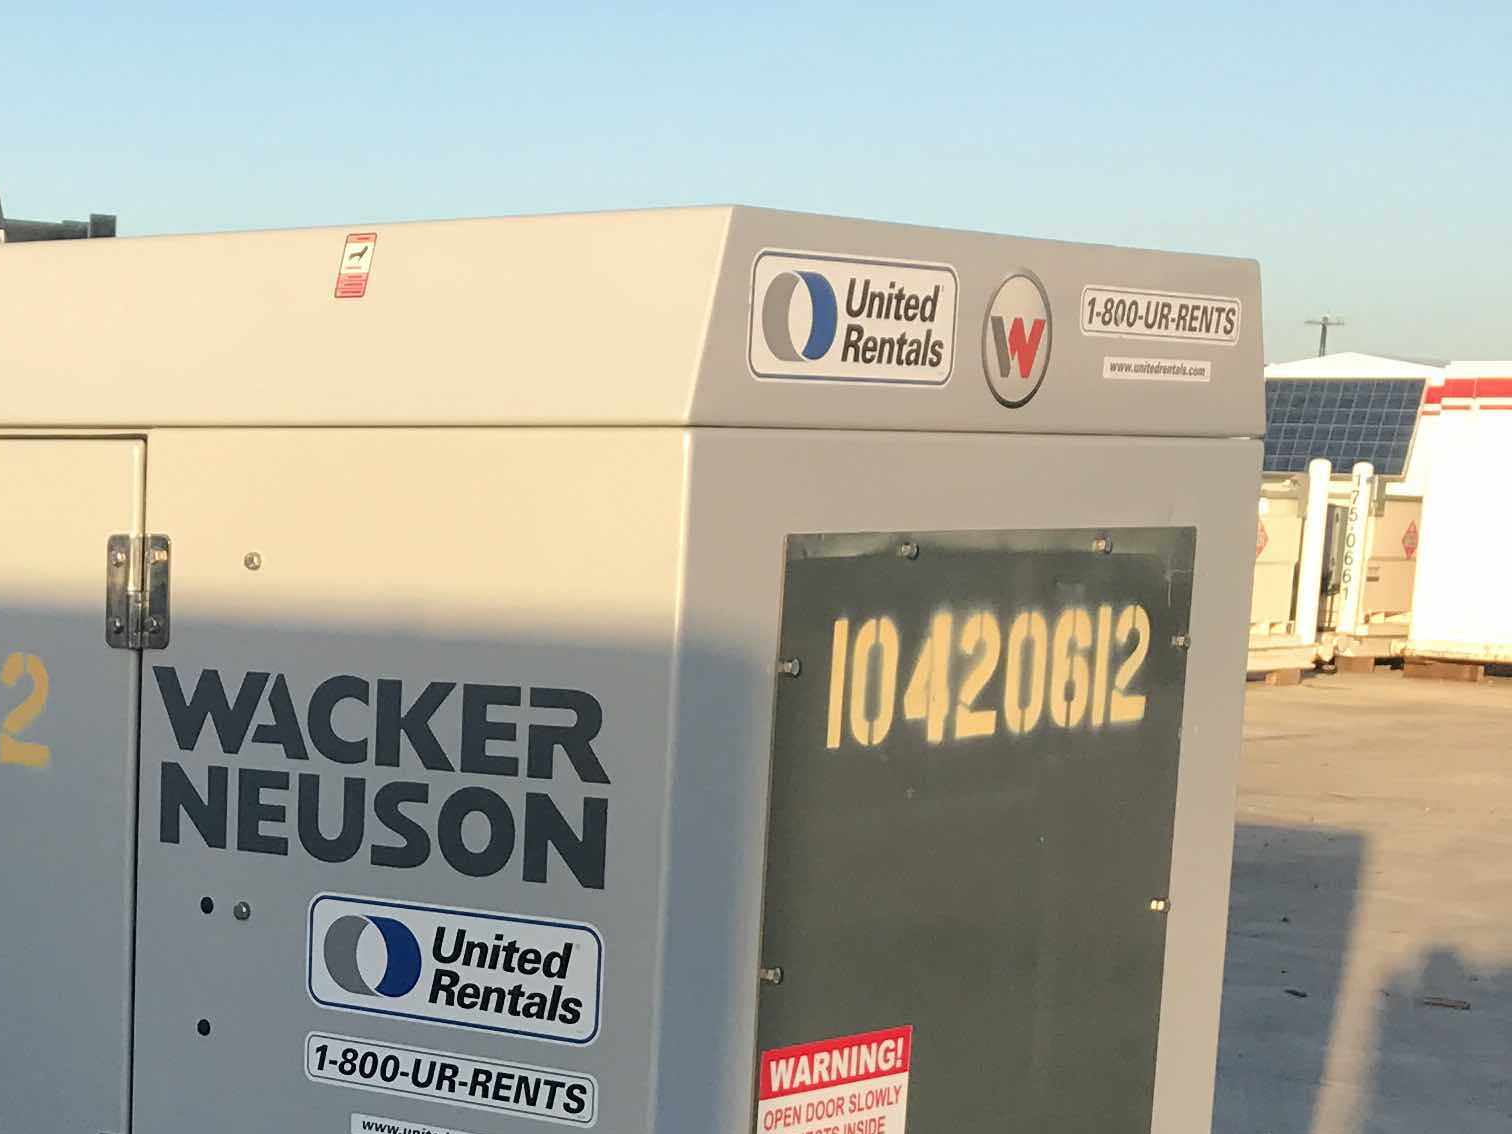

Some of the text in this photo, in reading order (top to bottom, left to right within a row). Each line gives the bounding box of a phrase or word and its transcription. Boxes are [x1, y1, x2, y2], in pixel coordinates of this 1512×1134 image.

[845, 278, 941, 322] United
[1087, 296, 1237, 335] 1-800-UR-RENTS
[841, 324, 944, 367] Rentals
[1109, 360, 1206, 377] www.unitedrentals.com
[826, 603, 1151, 749] 10420612
[152, 666, 611, 784] WACKER
[159, 761, 609, 890] NEUSON
[432, 926, 573, 979] United
[428, 968, 583, 1024] Rentals
[315, 1044, 587, 1114] 1-800-UR-RENTS
[769, 1037, 904, 1092] WARNING!
[763, 1085, 902, 1131] OPEN DOOR SLOWLY
